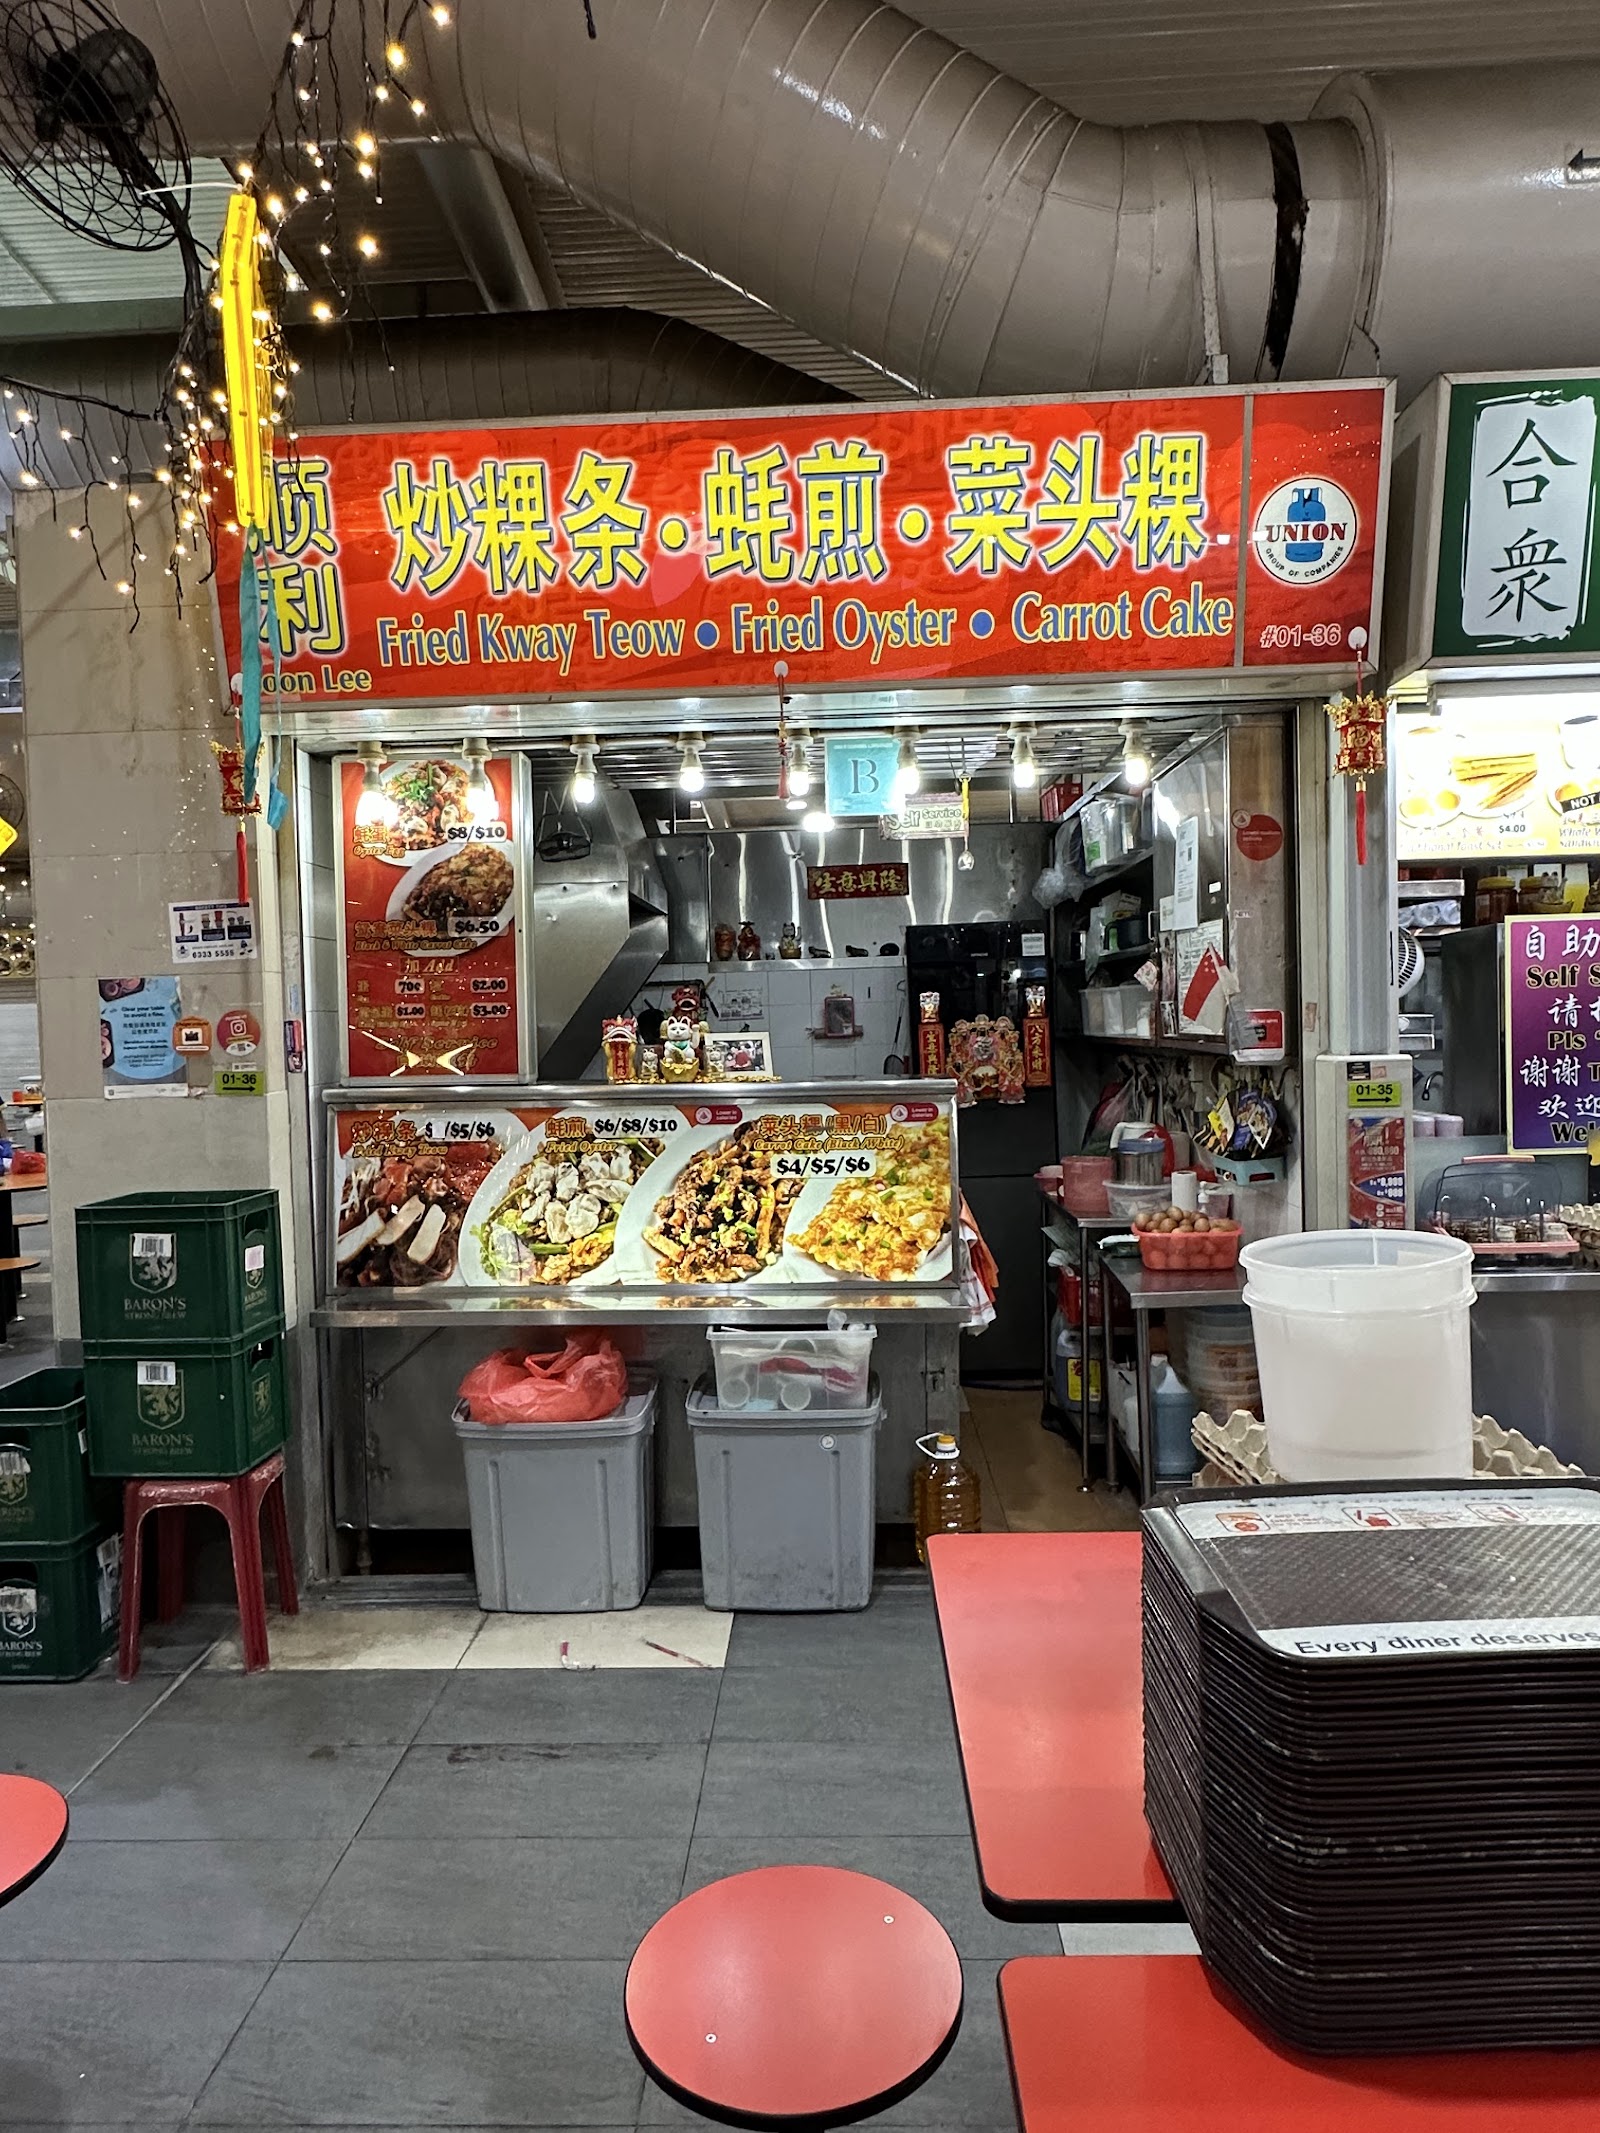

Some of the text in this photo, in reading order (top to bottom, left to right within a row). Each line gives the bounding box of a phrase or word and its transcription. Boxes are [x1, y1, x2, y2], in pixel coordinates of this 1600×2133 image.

[384, 431, 1209, 598] 炒粿条 蚝煎 菜头粿
[1265, 522, 1349, 543] UNION
[1265, 545, 1345, 578] GROUP OF COMPANIES
[1011, 581, 1234, 644] Carrot Cake
[731, 596, 958, 665] Fried Oyster
[1259, 622, 1342, 648] #01-36
[378, 607, 686, 677] Fried Kway Teow
[260, 663, 373, 694] oon Lee
[850, 758, 880, 794] B
[1570, 793, 1597, 811] NOT
[921, 807, 962, 820] Service
[447, 825, 506, 843] $8/$10
[1499, 823, 1526, 834] $4.00
[454, 919, 500, 935] $6.50
[472, 979, 506, 991] $2.00
[1525, 963, 1581, 989] Self
[396, 1003, 425, 1016] $1.00
[472, 1003, 508, 1017] $3.00
[1547, 1030, 1587, 1051] Pls
[222, 1073, 257, 1085] 01-36
[1519, 1053, 1582, 1088] 谢谢
[1355, 1084, 1393, 1096] 01-35
[425, 1121, 496, 1141] $/$5/$6
[545, 1116, 587, 1139] 蚝煎
[594, 1117, 678, 1136] $6/$8/$10
[418, 1144, 449, 1156] Teow
[545, 1141, 618, 1155] Fried Oyster
[753, 1138, 793, 1151] Carrot
[794, 1138, 823, 1151] Cake
[776, 1156, 871, 1176] $4/$5/$6
[124, 1296, 187, 1313] BARON'S
[131, 1433, 194, 1447] BARON'S
[1295, 1640, 1378, 1654] Every
[1388, 1635, 1461, 1651] diner
